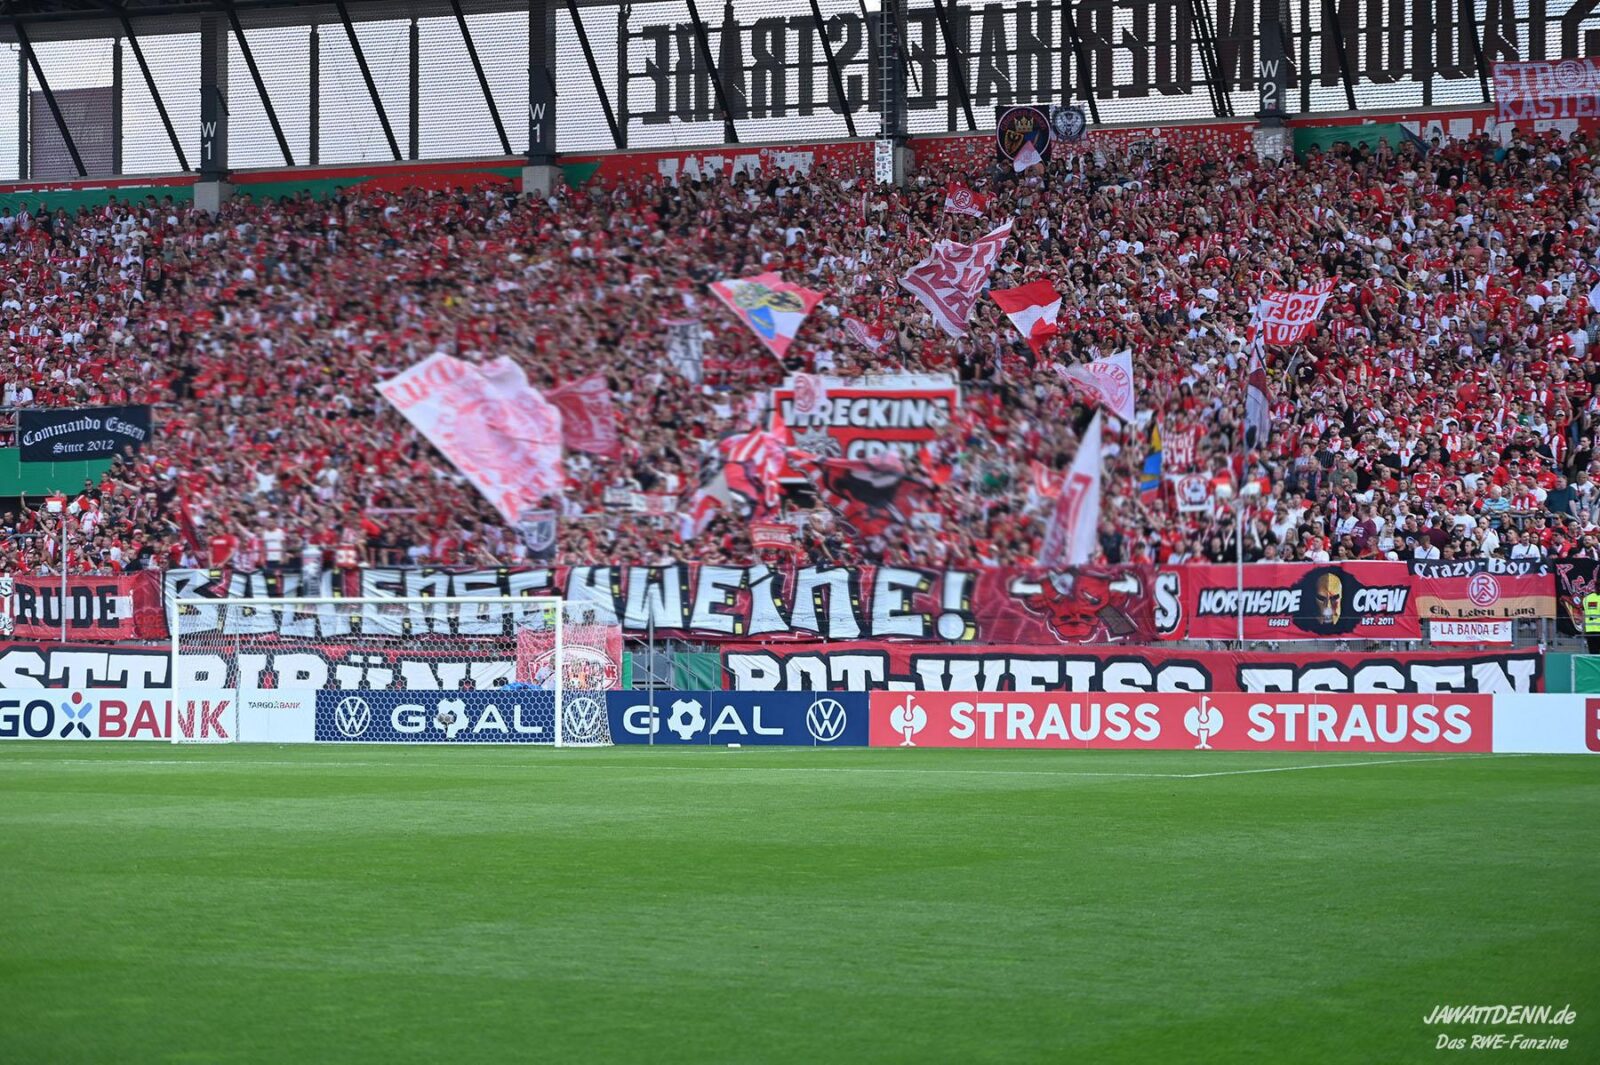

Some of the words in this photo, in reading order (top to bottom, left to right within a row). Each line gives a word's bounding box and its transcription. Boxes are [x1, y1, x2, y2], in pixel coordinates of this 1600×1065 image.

[1260, 61, 1280, 78] W
[530, 103, 546, 120] W
[1497, 94, 1600, 121] KASTE
[201, 122, 217, 138] W
[533, 124, 541, 143] 1
[204, 141, 213, 160] 1
[781, 397, 949, 428] WRECKING
[22, 416, 101, 446] Commando
[105, 416, 147, 441] Essen
[52, 441, 85, 454] Since
[87, 439, 115, 451] 2012
[15, 583, 121, 628] RUDE
[1199, 588, 1302, 614] NORTHSIDE
[1352, 588, 1407, 613] CREW
[1504, 606, 1536, 617] Lang
[1268, 618, 1289, 627] ESSEN
[1361, 617, 1376, 626] EST.
[1377, 617, 1395, 625] 2011
[1441, 623, 1454, 635] LA
[1457, 623, 1489, 635] BANDA
[1493, 623, 1500, 635] E
[1241, 659, 1536, 693] ESSEN
[949, 702, 1161, 740] STRAUSS
[1247, 703, 1472, 744] STRAUSS
